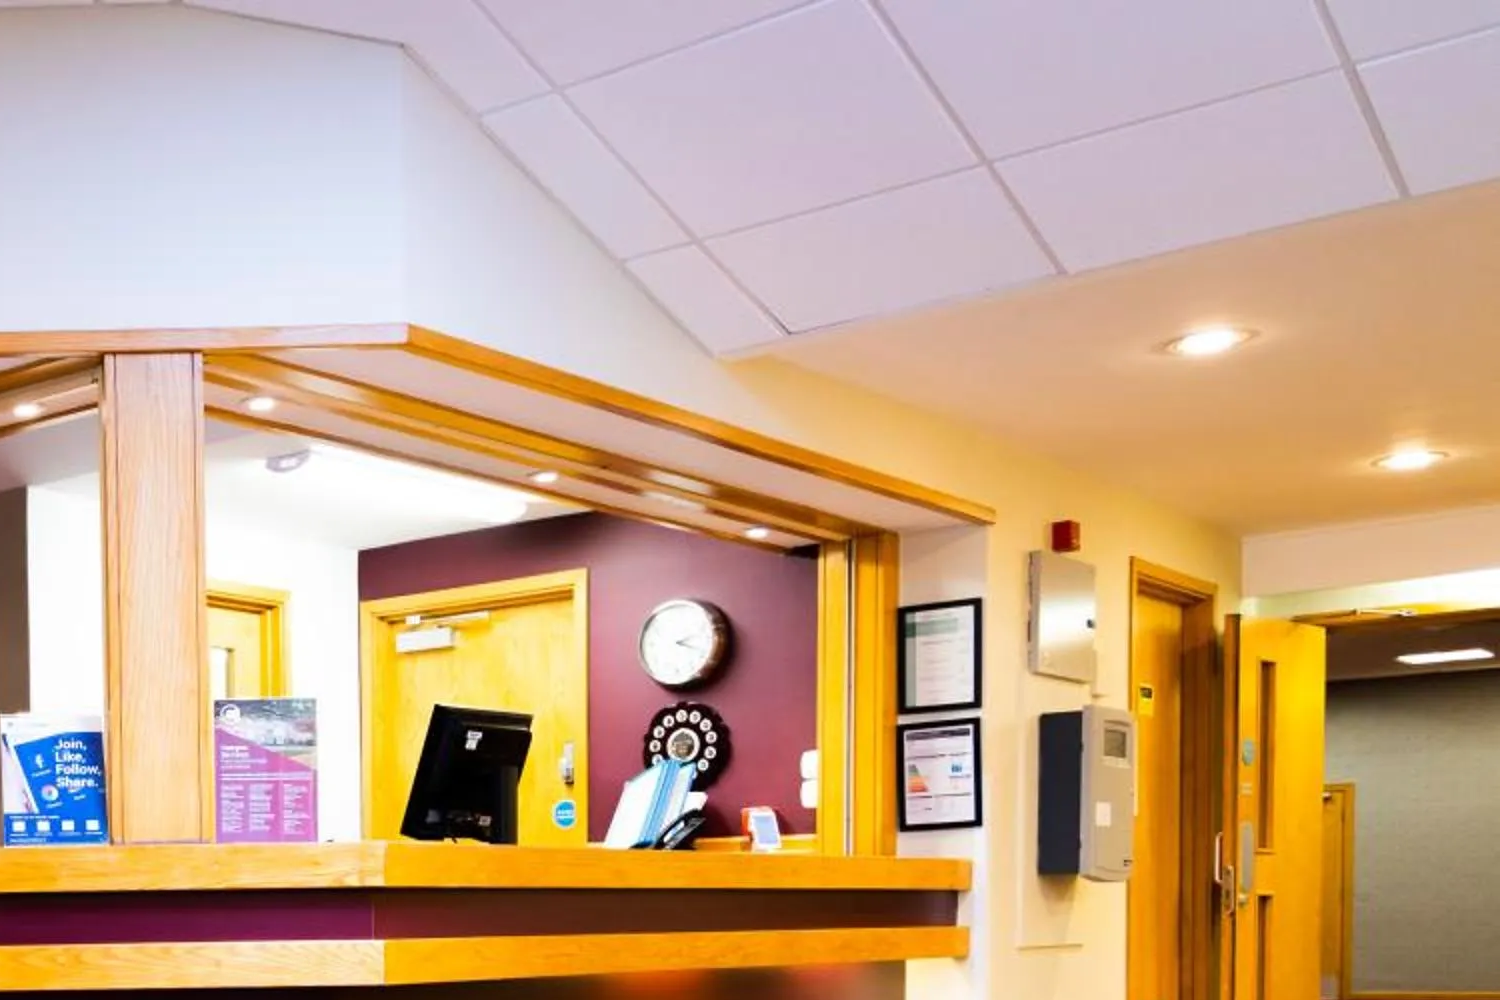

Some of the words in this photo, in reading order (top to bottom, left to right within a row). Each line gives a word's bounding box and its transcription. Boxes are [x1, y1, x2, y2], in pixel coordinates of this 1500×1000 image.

[54, 738, 87, 751] Join,
[55, 751, 87, 764] Like,
[55, 764, 102, 777] Follow,
[57, 776, 99, 788] Share.
